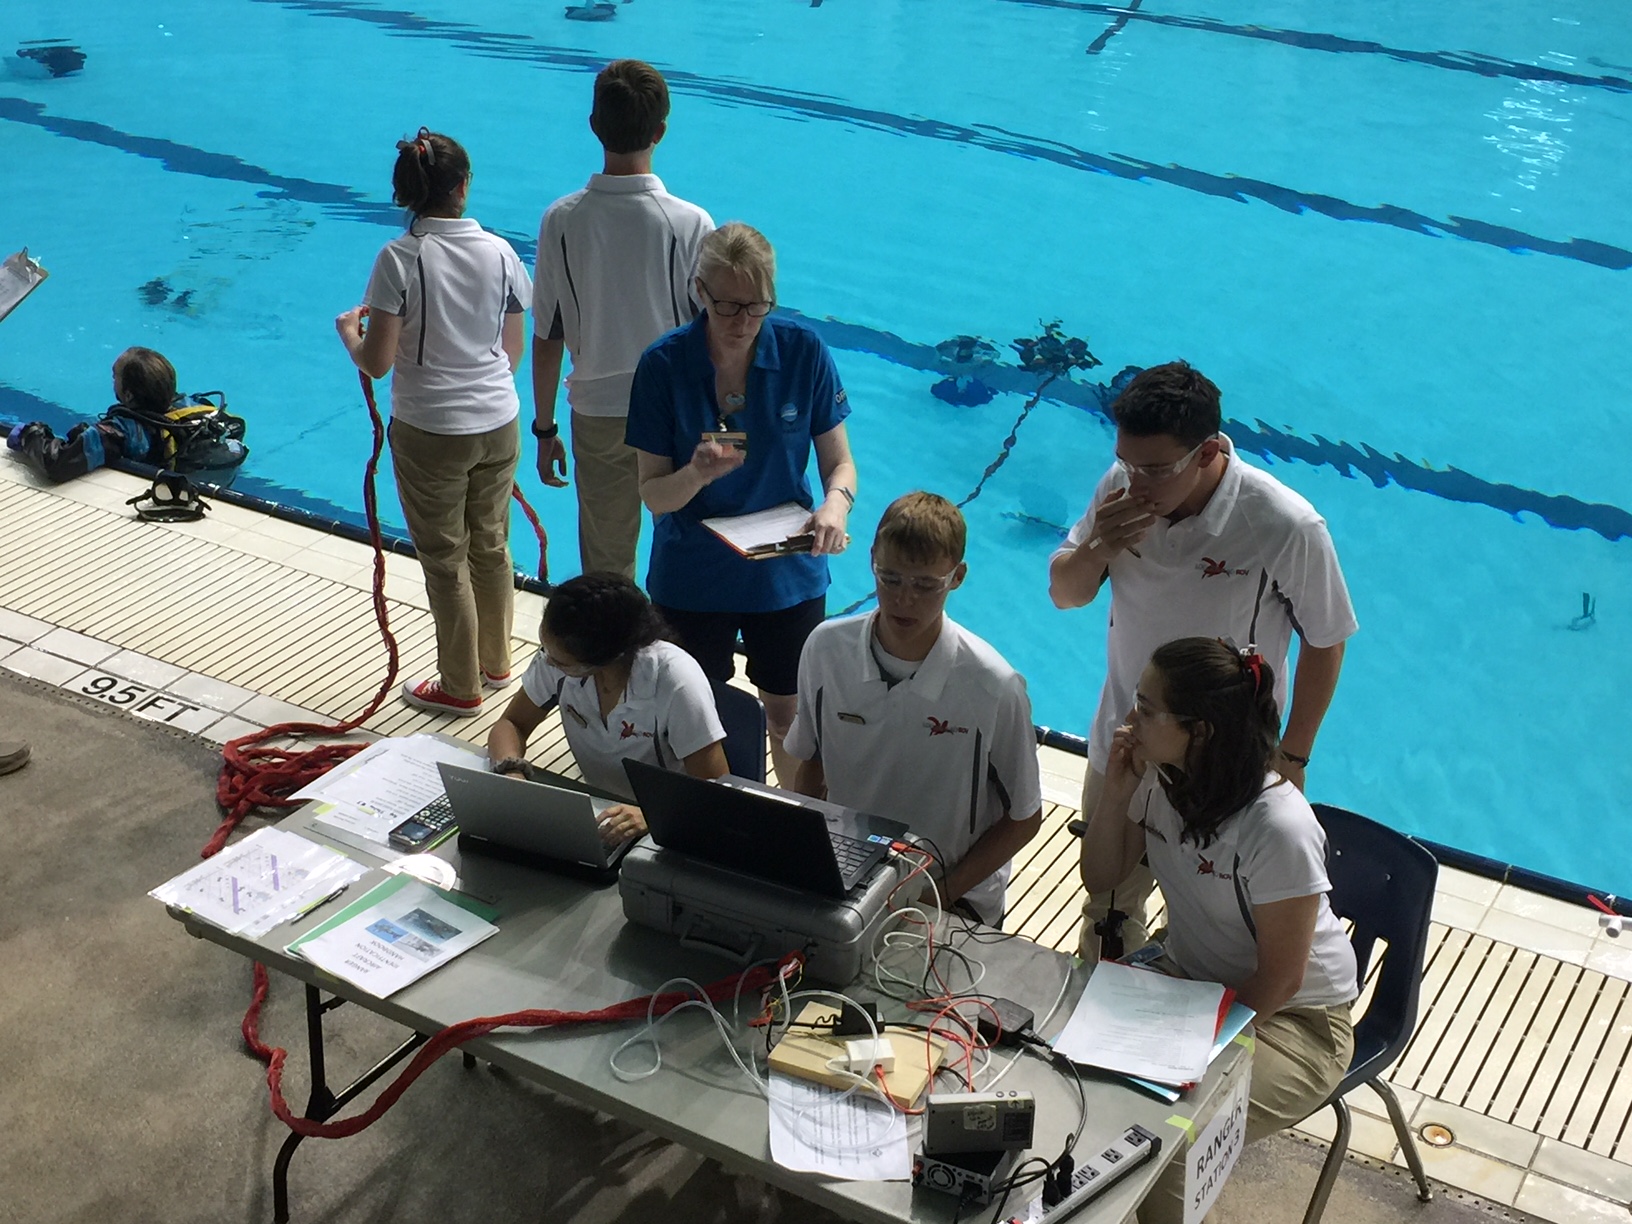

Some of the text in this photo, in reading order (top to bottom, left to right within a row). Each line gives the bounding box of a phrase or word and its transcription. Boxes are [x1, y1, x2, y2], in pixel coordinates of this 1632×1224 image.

[81, 676, 200, 722] 9.5 FT
[1194, 1128, 1240, 1211] STATION 3
[1195, 1097, 1242, 1180] RANGER
